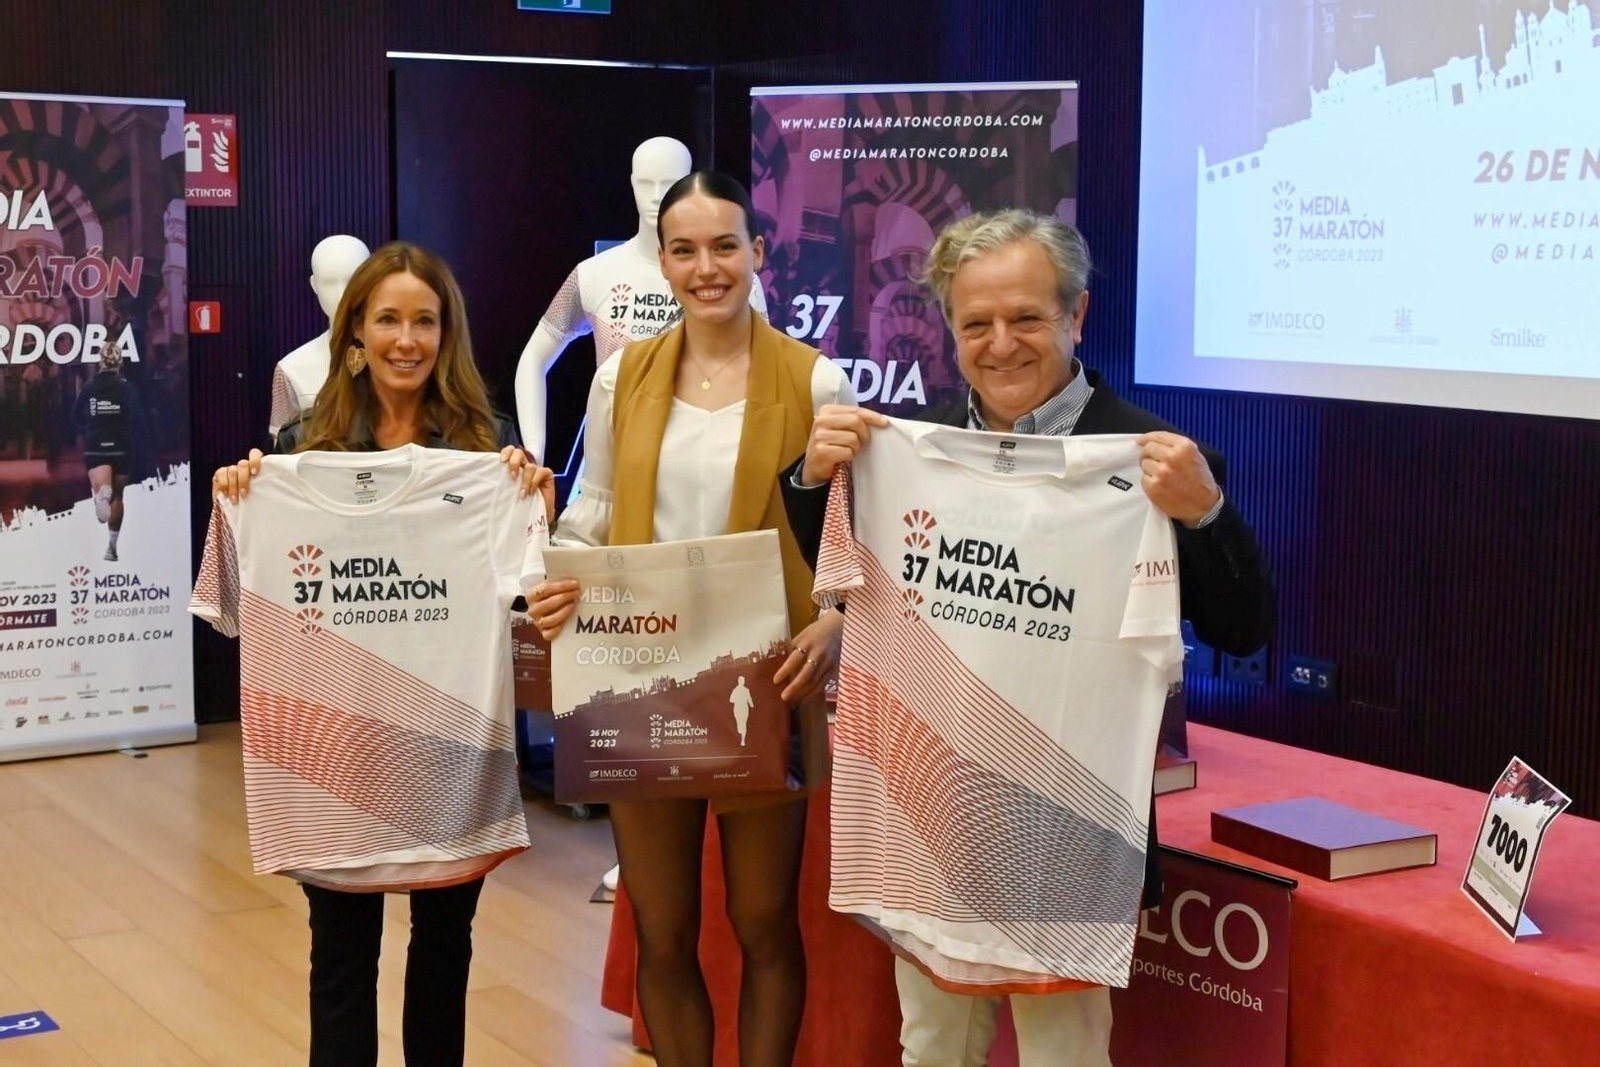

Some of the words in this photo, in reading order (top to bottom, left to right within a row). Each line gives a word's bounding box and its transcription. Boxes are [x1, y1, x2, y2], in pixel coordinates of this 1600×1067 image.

[780, 114, 1044, 131] WWW.MEDIAMARATONCORDOBA.COM
[809, 147, 1009, 162] @MEDIAMARATONCORDOBA
[1473, 150, 1514, 183] 26
[1525, 148, 1570, 182] DE
[1299, 196, 1351, 216] MEDIA
[1272, 217, 1293, 238] 37
[1299, 214, 1385, 240] MARATÓN
[1491, 243, 1594, 264] @MEDIA
[634, 293, 678, 307] MEDIA
[610, 305, 629, 319] 37
[785, 294, 844, 339] 37
[1265, 312, 1325, 331] IMDECO
[938, 535, 1020, 574] MEDIA
[330, 557, 402, 580] MEDIA
[94, 573, 141, 588] MEDIA
[294, 580, 323, 604] 37
[332, 573, 448, 604] MARATÓN
[902, 553, 930, 584] 37
[935, 563, 1076, 615] MARATÓN
[22, 592, 57, 606] 2023
[70, 589, 89, 605] 37
[95, 583, 170, 605] MARATÓN
[332, 607, 409, 626] CÓRDOBA
[414, 607, 449, 622] 2023
[575, 610, 678, 635] MARATÓN
[930, 600, 1017, 634] CÓRDOBA
[1026, 619, 1072, 643] 2023
[576, 642, 681, 667] CÓRDOBA
[589, 729, 600, 737] 26
[601, 729, 620, 737] NOV
[650, 727, 661, 737] 37
[664, 725, 708, 737] MARATÓN
[664, 719, 691, 728] MEDIA
[590, 739, 617, 748] 2023
[600, 768, 638, 778] IMDECO
[1487, 813, 1528, 873] 7000
[1188, 972, 1264, 1012] Córdoba
